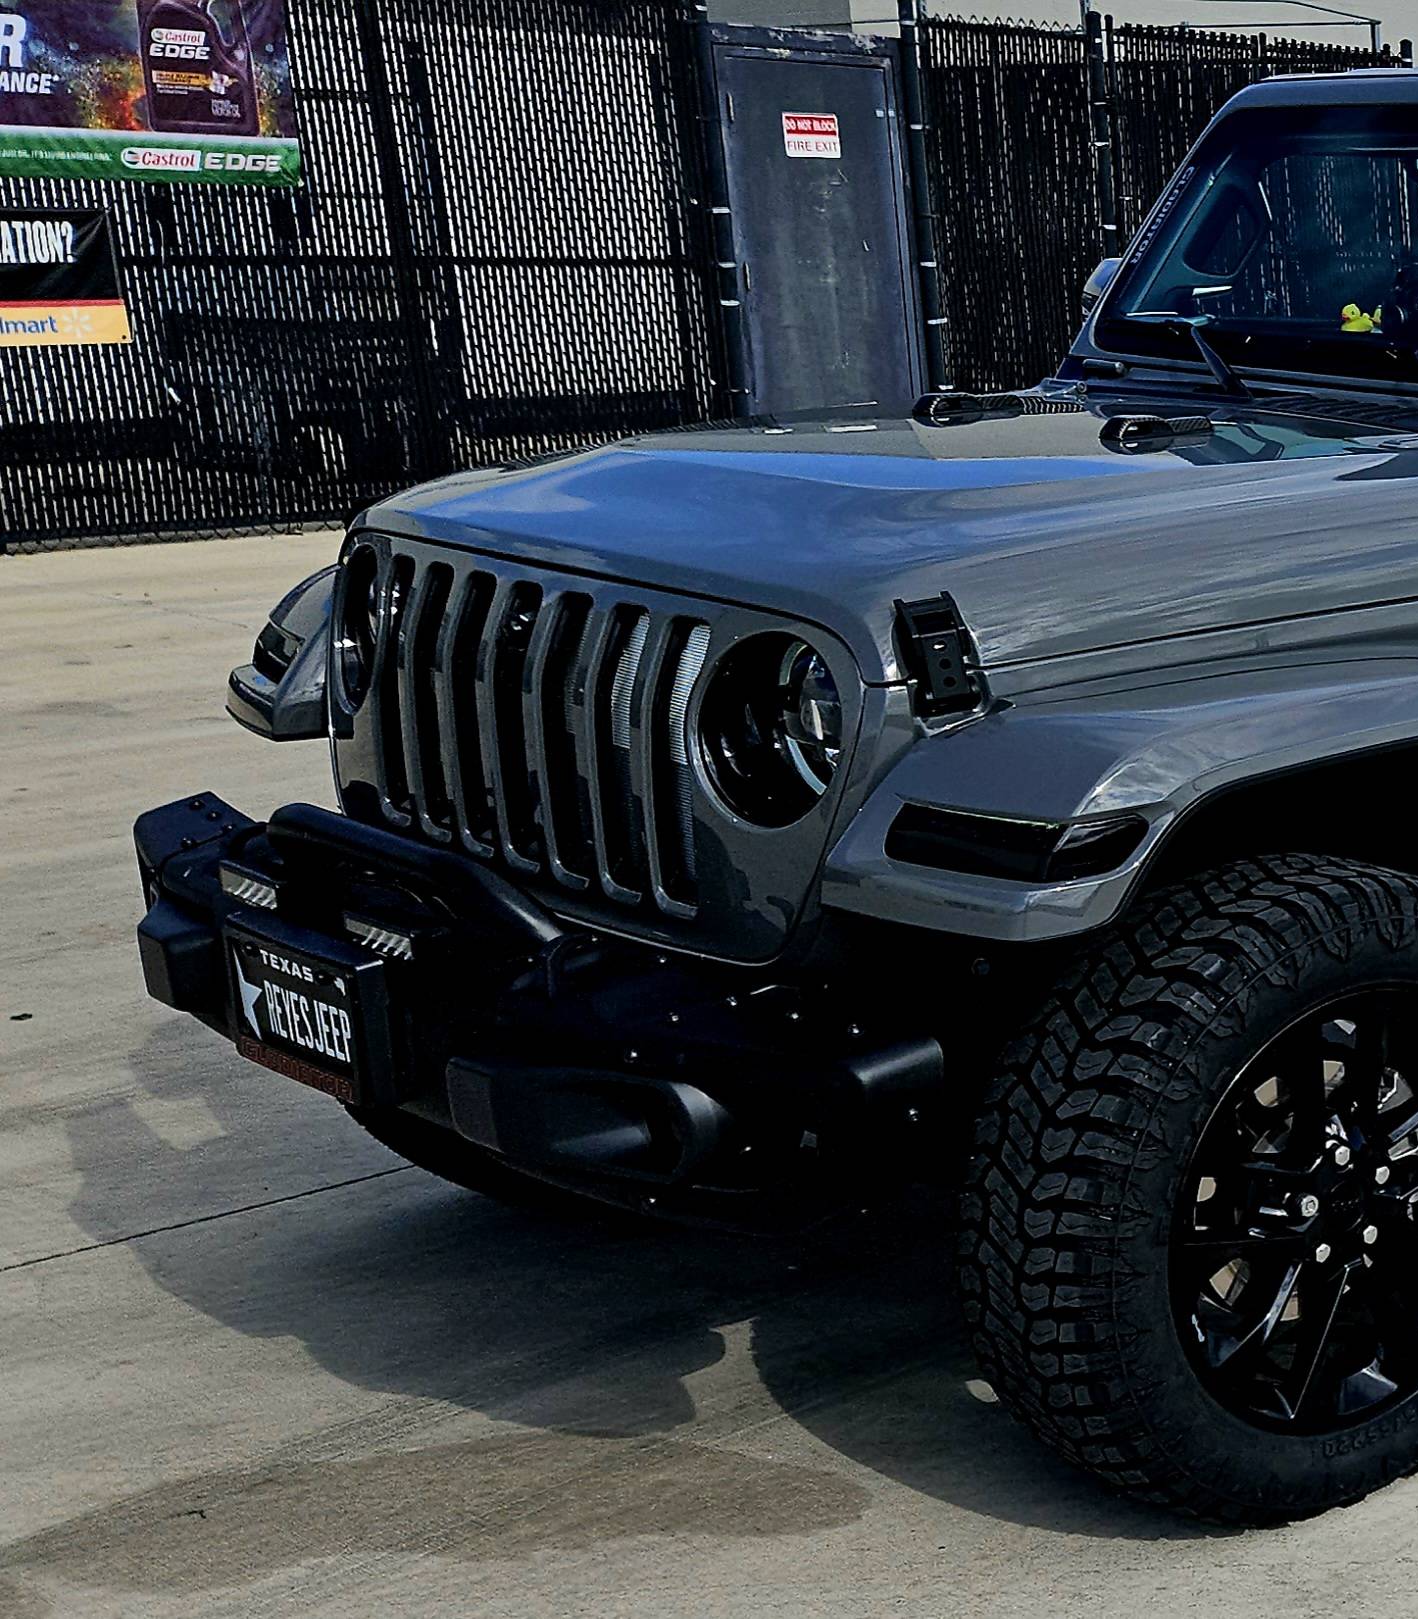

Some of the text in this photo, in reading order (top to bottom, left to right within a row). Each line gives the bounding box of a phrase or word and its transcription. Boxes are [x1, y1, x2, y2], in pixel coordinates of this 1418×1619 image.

[165, 32, 201, 43] Castrol
[150, 43, 210, 60] EDGE
[785, 119, 796, 130] DO
[797, 119, 812, 130] NOT
[787, 141, 837, 152] FIRE EXIT
[142, 151, 282, 172] Castrol EDGE
[0, 220, 73, 264] ATION?
[259, 949, 314, 983] TEXAS
